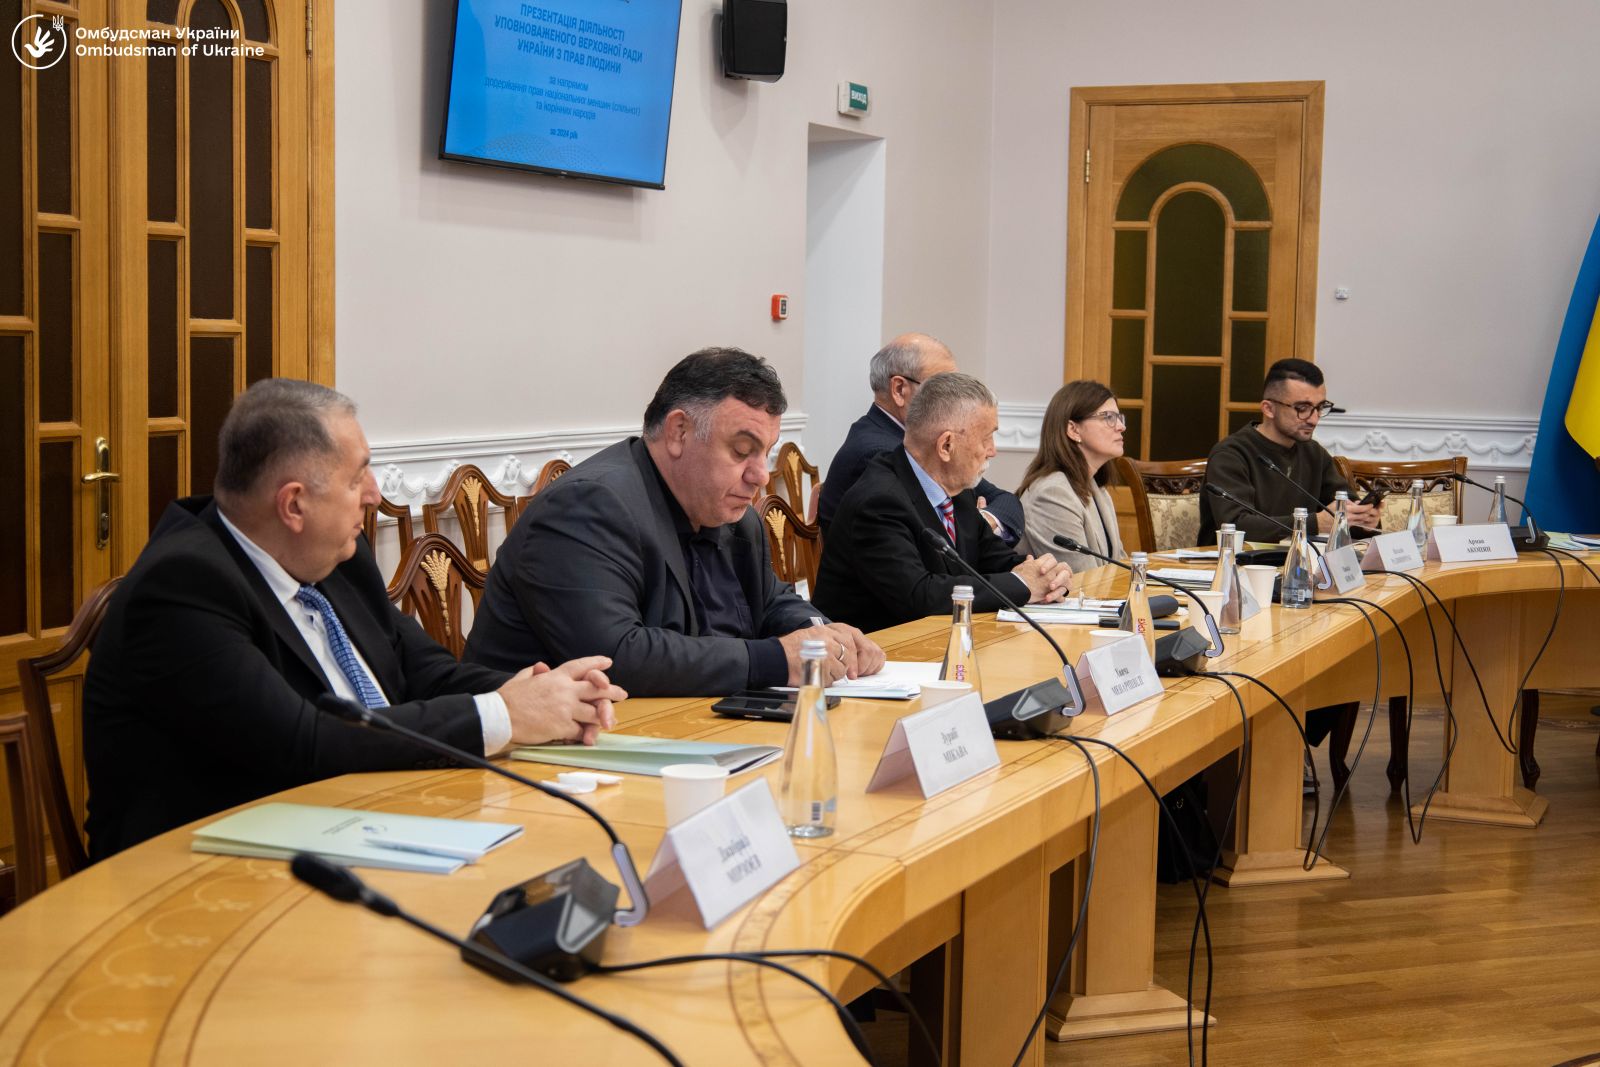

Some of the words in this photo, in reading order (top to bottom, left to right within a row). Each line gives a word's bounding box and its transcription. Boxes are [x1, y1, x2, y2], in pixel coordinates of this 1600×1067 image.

[494, 15, 576, 45] УПОВНОВАЖЕНОГО
[579, 35, 621, 57] ВЕРХОВНОЇ
[622, 47, 643, 63] РАДИ
[520, 4, 577, 29] ПРЕЗЕНТАЦІЯ
[579, 18, 625, 41] ДІЯЛЬНОСТІ
[518, 38, 554, 59] УКРАЇНИ
[557, 47, 562, 60] З
[564, 49, 585, 66] ПРАВ
[586, 54, 622, 74] ЛЮДИНИ
